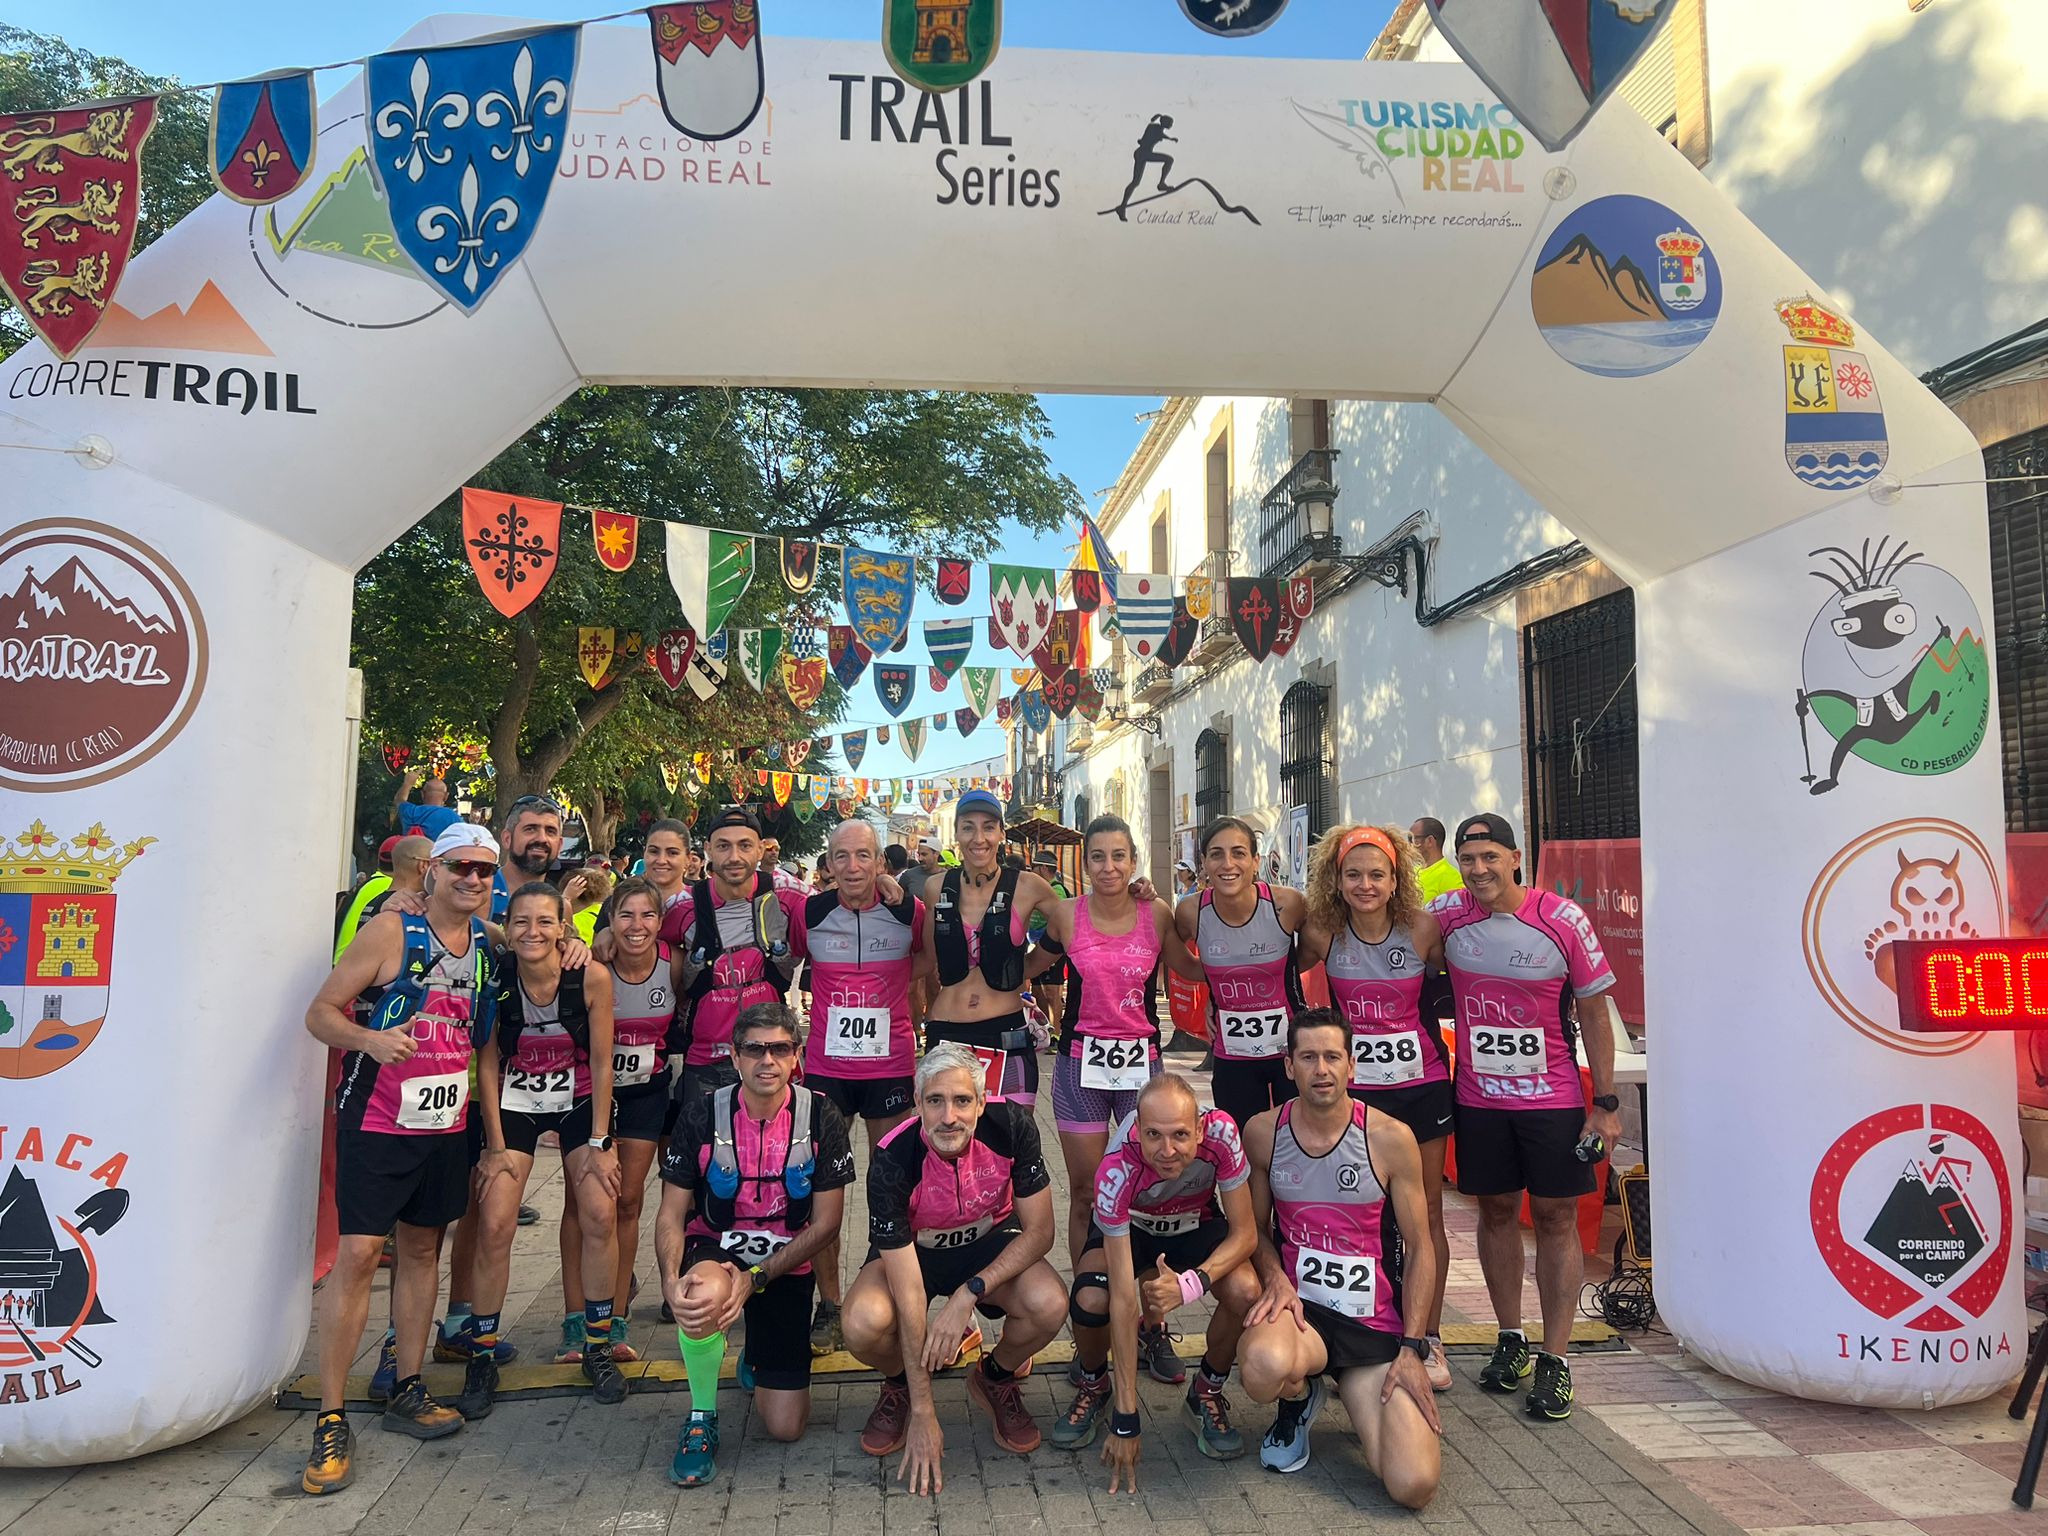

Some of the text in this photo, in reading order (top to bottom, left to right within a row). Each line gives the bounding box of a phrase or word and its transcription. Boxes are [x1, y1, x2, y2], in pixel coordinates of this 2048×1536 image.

[828, 73, 1013, 147] TRAIL
[1337, 98, 1519, 131] TURISMO
[738, 140, 772, 156] DE
[1375, 126, 1525, 161] CIUDAD
[682, 158, 772, 186] REAL
[935, 147, 1061, 208] Series
[1422, 156, 1525, 193] REAL
[1136, 207, 1220, 227] Ciudad Real
[1317, 205, 1346, 229] lugar
[1352, 212, 1374, 230] que
[1381, 210, 1437, 230] siempre
[8, 357, 318, 416] CORRETRAIL
[85, 725, 124, 760] REAL)
[1900, 757, 1919, 770] CD
[1923, 731, 1980, 771] PESEBRILLO
[830, 985, 866, 1008] phi
[1218, 977, 1254, 1003] phi
[1346, 995, 1383, 1022] phi
[1464, 992, 1507, 1026] phi
[839, 1017, 877, 1039] 204
[1225, 1014, 1283, 1038] 237
[1087, 1044, 1146, 1070] 262
[1354, 1038, 1418, 1064] 238
[1475, 1031, 1541, 1057] 258
[509, 1070, 571, 1093] 232
[417, 1083, 458, 1112] 208
[933, 1226, 978, 1249] 203
[1897, 1239, 1966, 1251] CORRIENDO
[1899, 1253, 1914, 1261] por
[1925, 1249, 1966, 1261] CAMPO
[1302, 1256, 1371, 1293] 252
[1924, 1272, 1946, 1284] CxC
[480, 1324, 494, 1332] STOP
[1836, 1331, 2011, 1364] IKENONA
